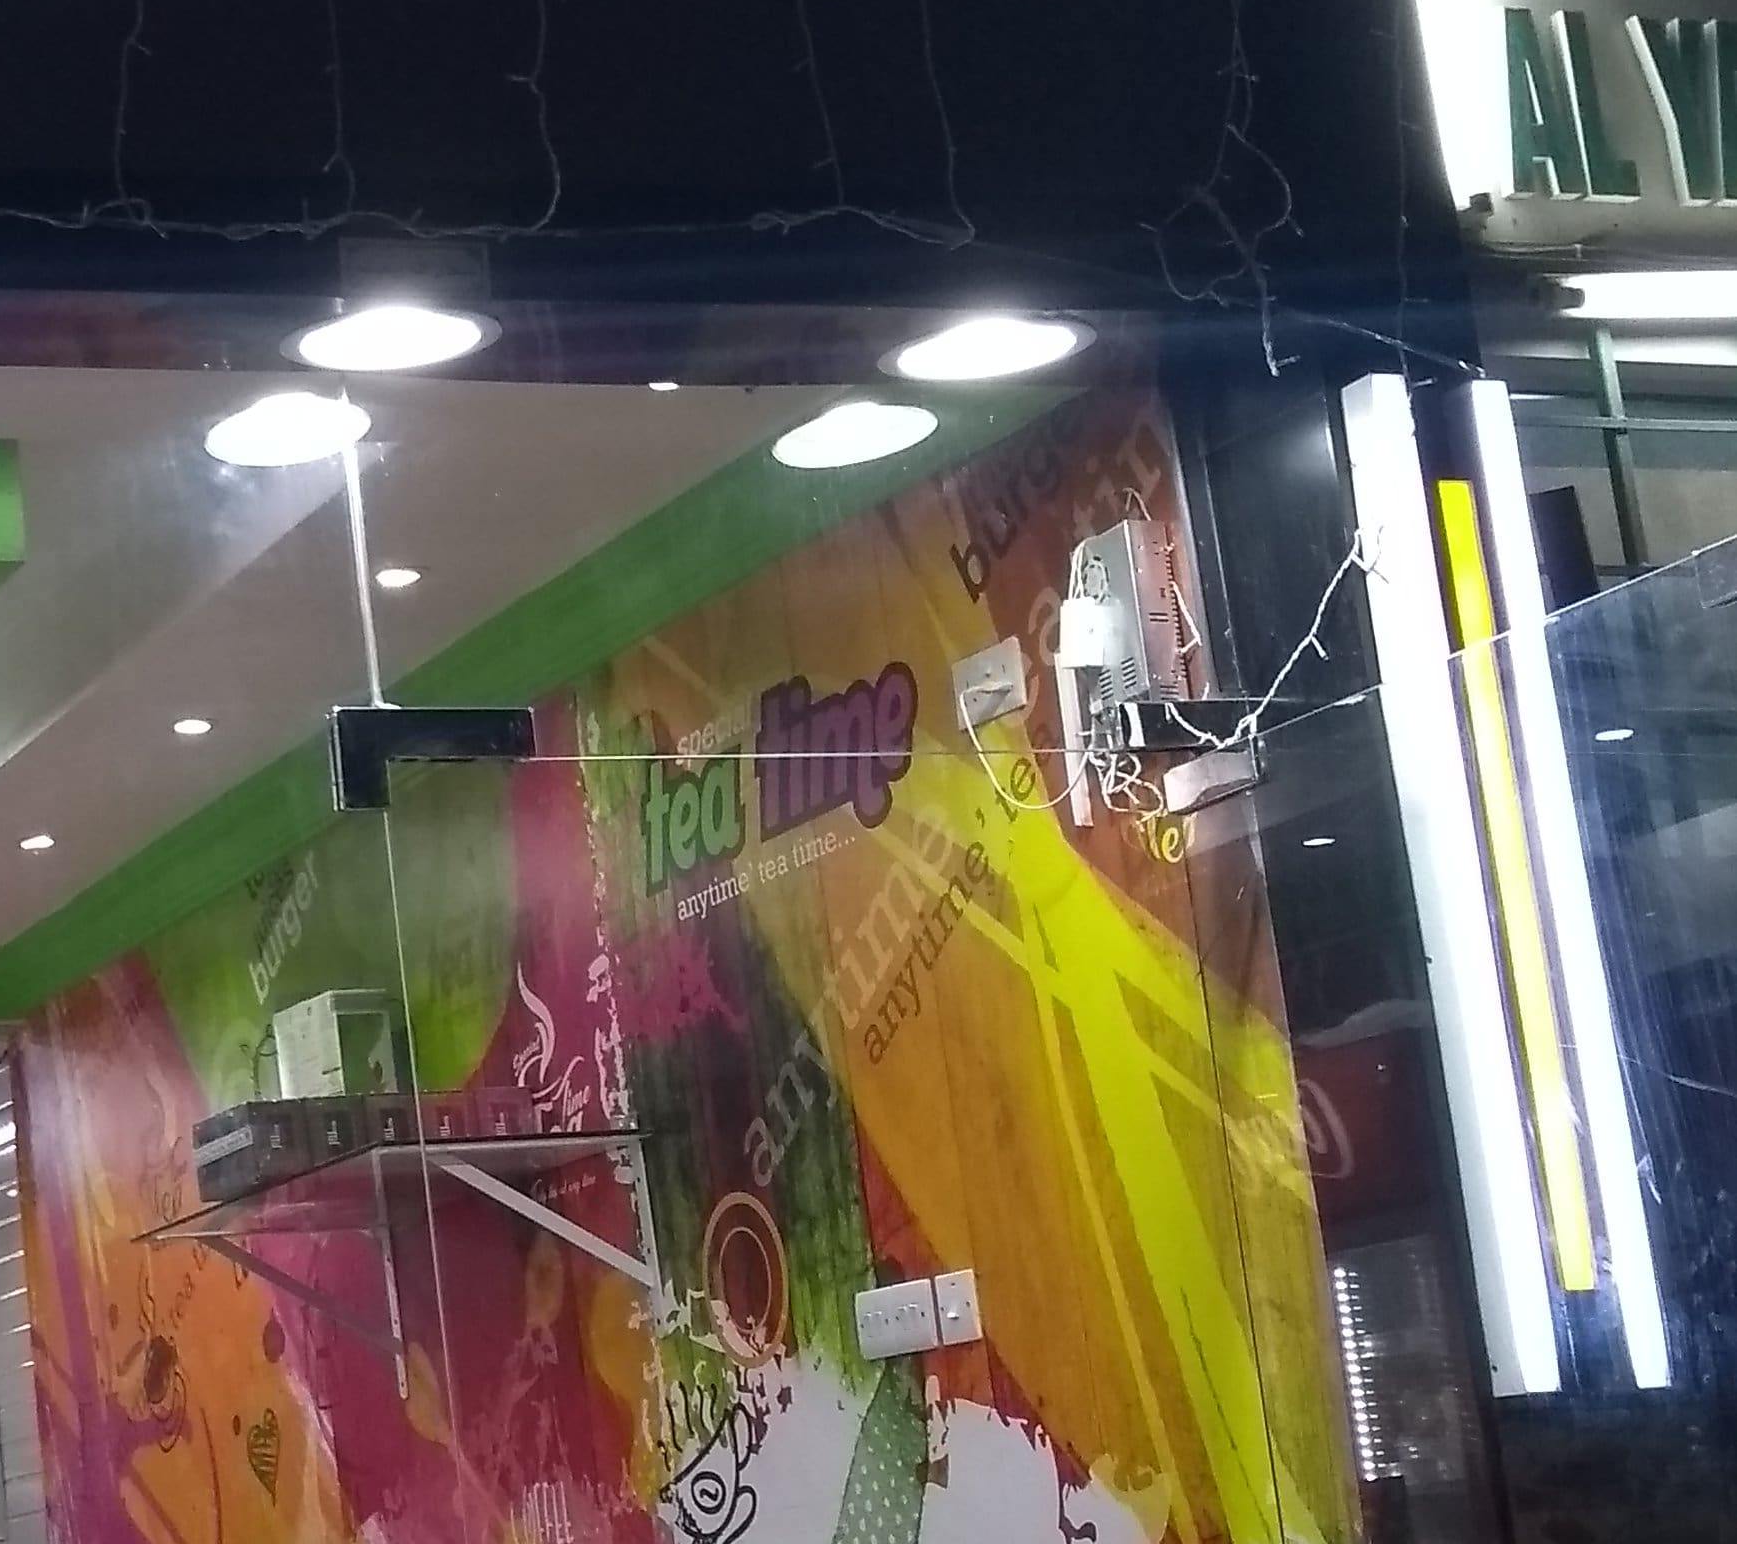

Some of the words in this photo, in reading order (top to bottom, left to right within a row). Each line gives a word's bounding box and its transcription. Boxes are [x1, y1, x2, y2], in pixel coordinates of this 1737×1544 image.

[1501, 5, 1642, 204] AL
[641, 744, 746, 898] tea
[755, 661, 919, 843] time
[758, 854, 790, 883] tea
